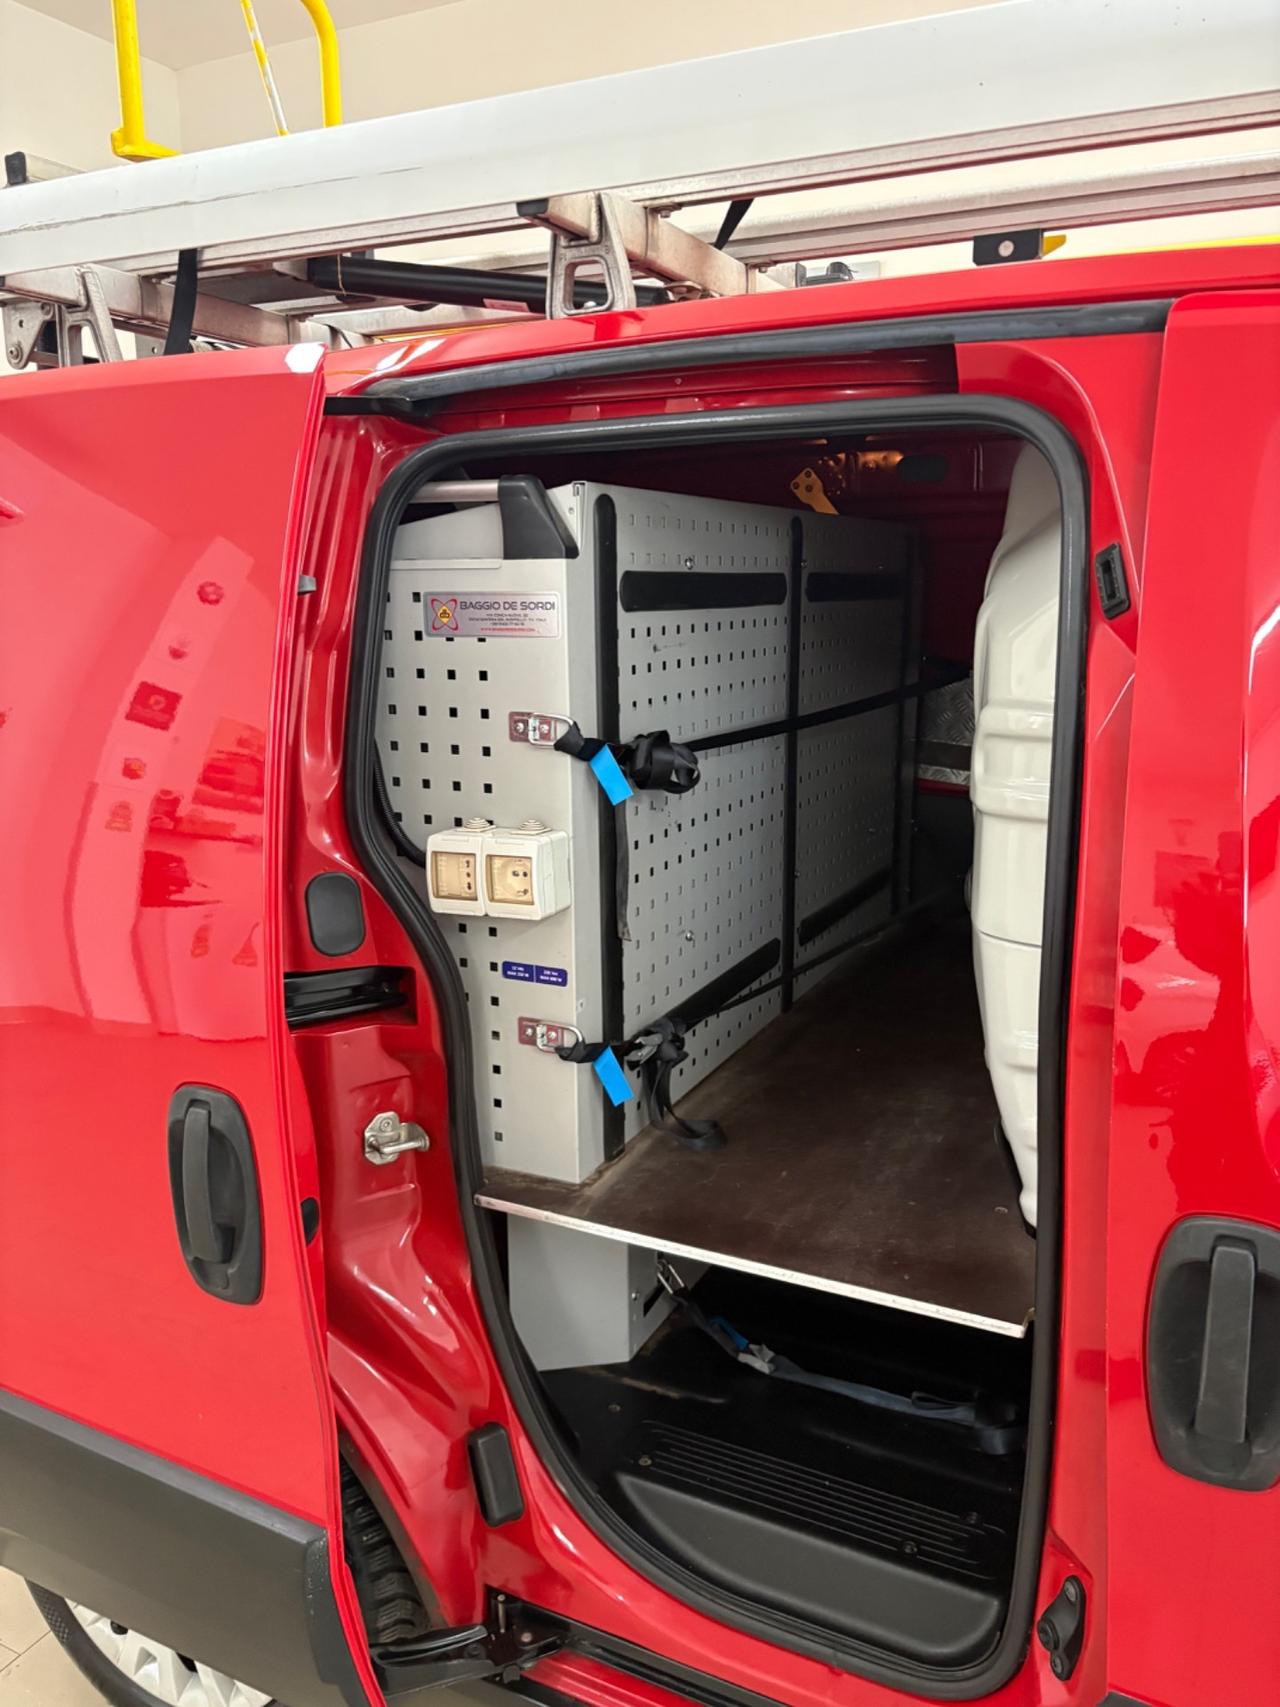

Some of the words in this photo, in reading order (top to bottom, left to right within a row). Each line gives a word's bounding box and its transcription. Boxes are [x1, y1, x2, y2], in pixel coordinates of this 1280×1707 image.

[460, 601, 501, 610] BAGGIO
[503, 601, 518, 610] DE
[520, 601, 555, 611] SORDI
